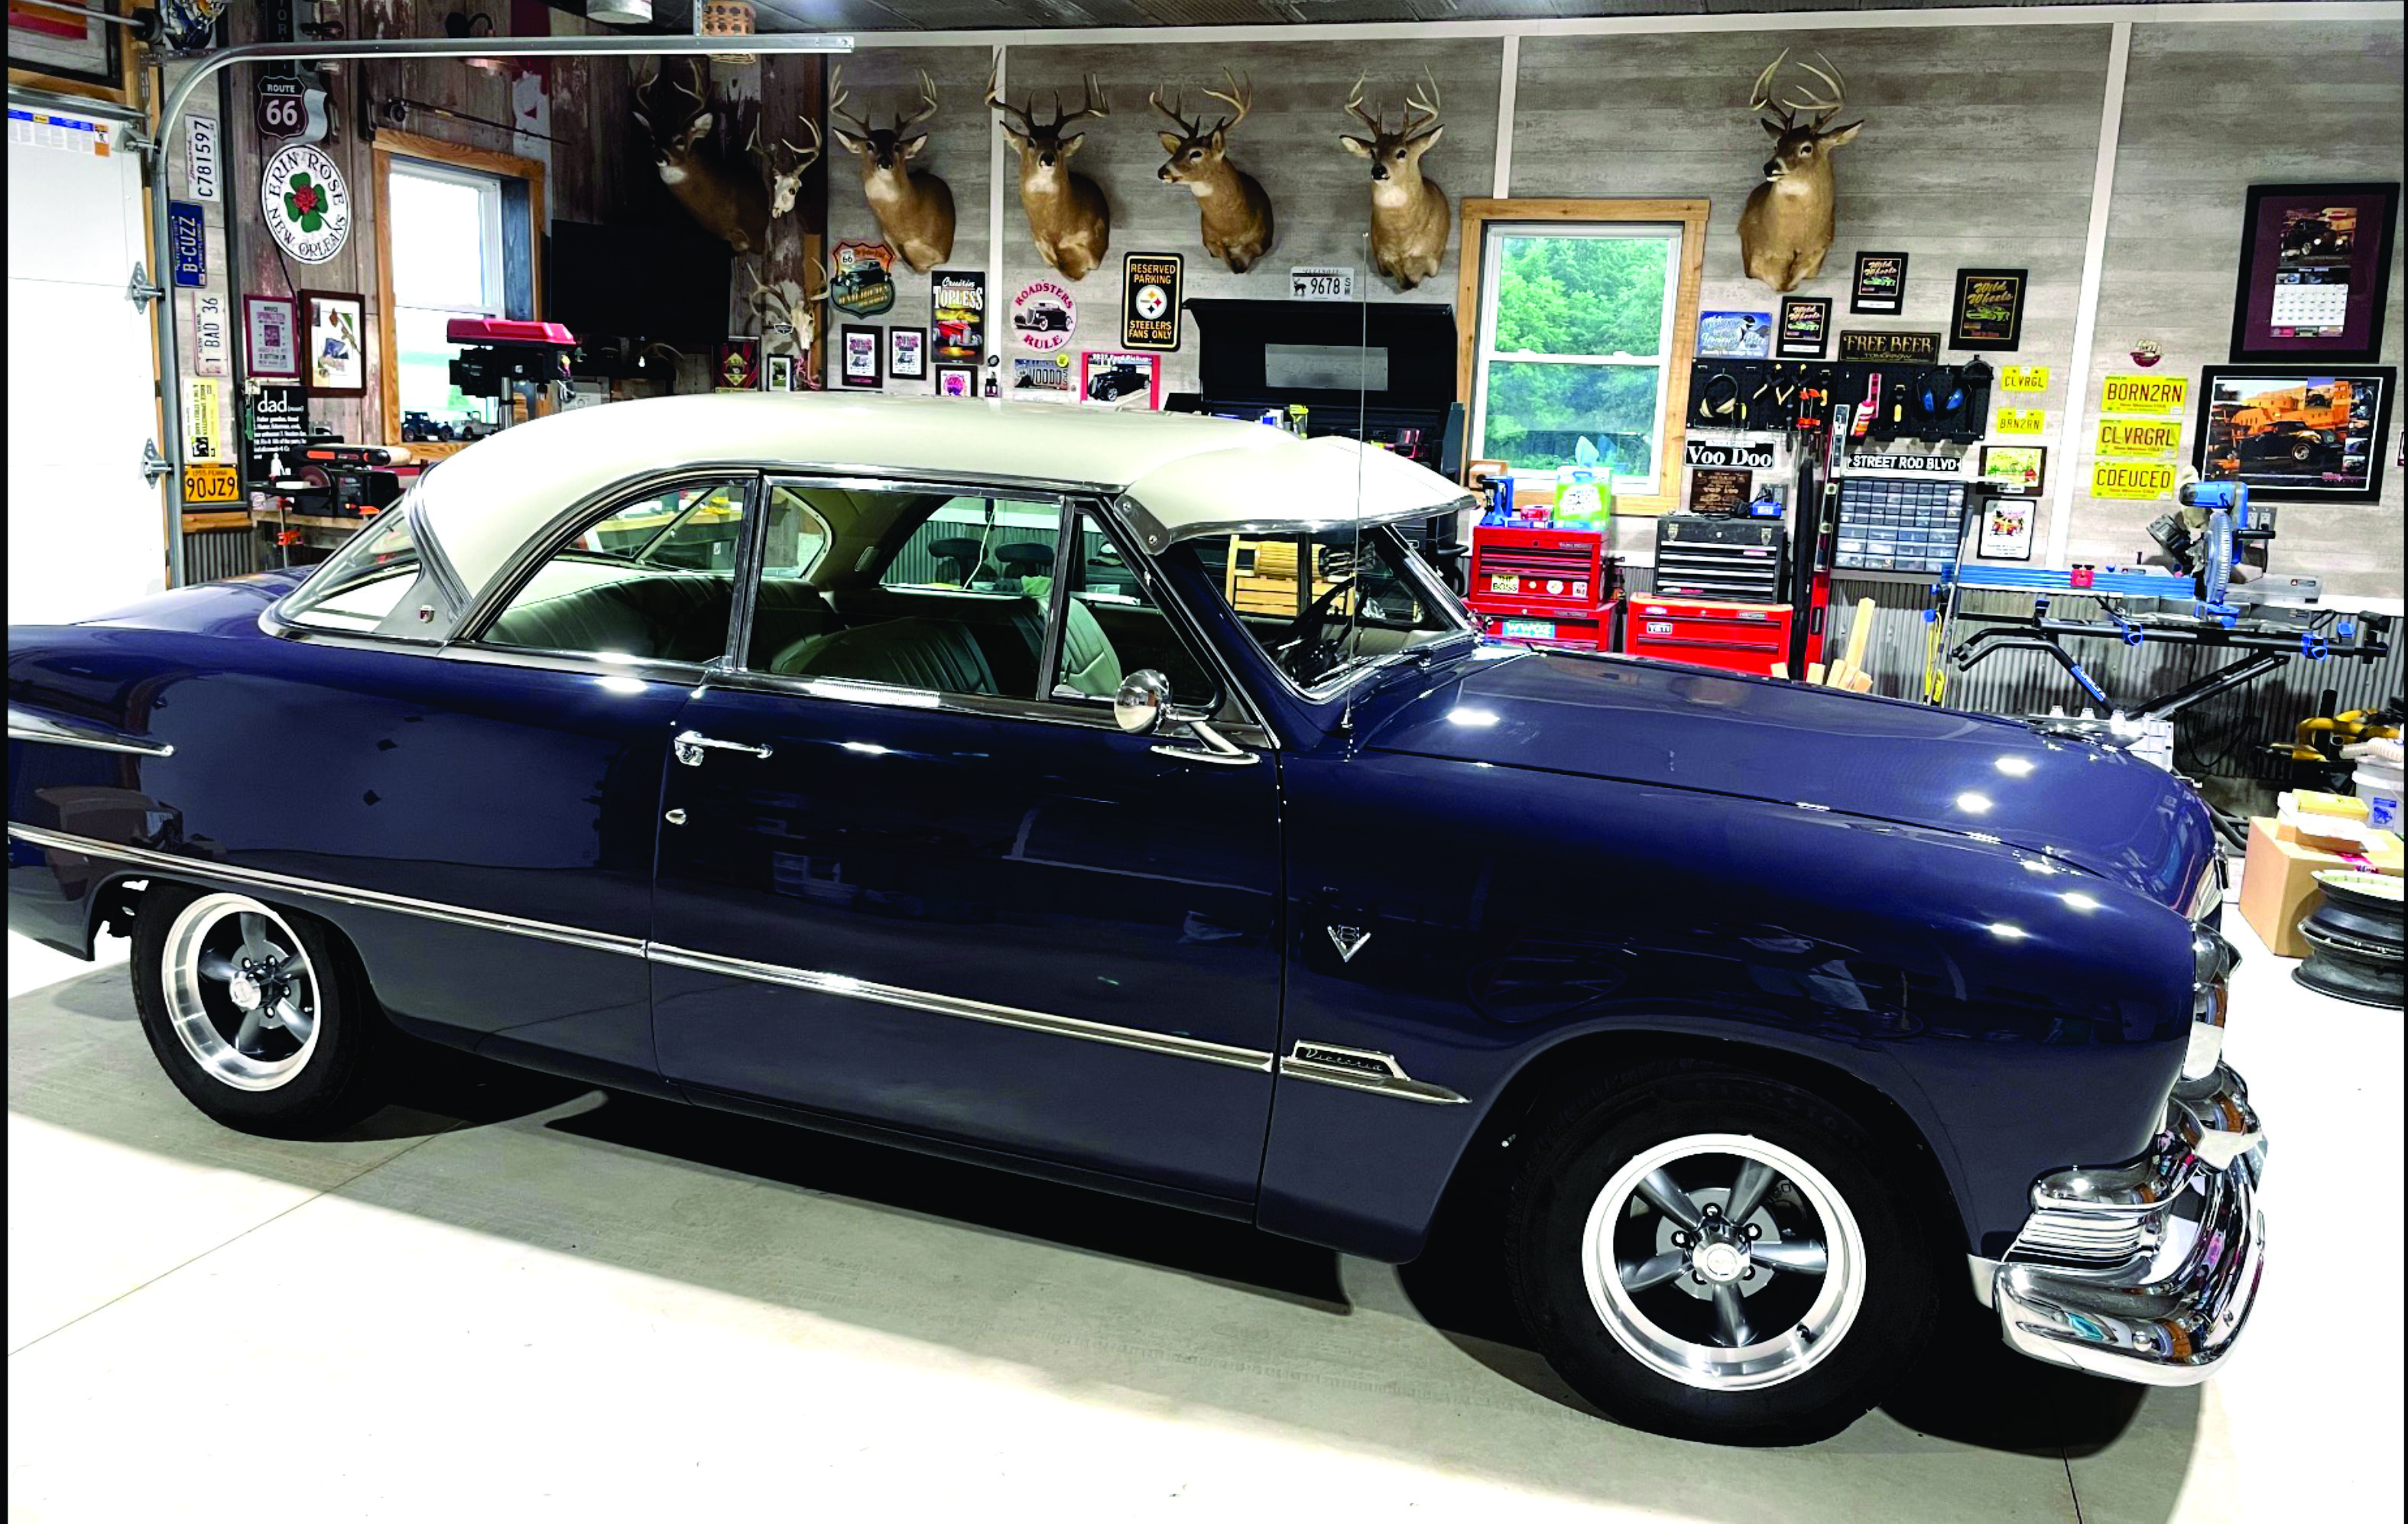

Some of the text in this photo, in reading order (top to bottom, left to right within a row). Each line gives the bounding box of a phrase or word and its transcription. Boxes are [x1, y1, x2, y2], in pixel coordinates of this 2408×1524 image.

[266, 83, 296, 93] ROUTE
[265, 99, 299, 125] 66
[193, 120, 213, 197] C781597
[268, 151, 345, 206] ERIN ROSE
[268, 207, 347, 258] NEW ORLEANS
[178, 216, 198, 272] B-CUZZ
[1131, 264, 1176, 274] RESERVED
[1864, 268, 1897, 276] Wheels
[1134, 274, 1171, 284] PARKING
[1310, 277, 1340, 294] 9678
[1973, 280, 2007, 293] Wild
[933, 285, 983, 310] TOPLESS
[1015, 282, 1073, 309] ROADSTERS
[1967, 292, 2014, 304] Wheels
[201, 297, 219, 314] 36
[1129, 319, 1172, 330] STEELERS
[1789, 312, 1822, 321] Wheels
[203, 323, 220, 348] BAD
[1023, 333, 1063, 349] RULE
[1128, 329, 1172, 339] FANS ONLY
[1845, 335, 1931, 352] FREE BEER
[2107, 382, 2182, 403] BORN2RN
[257, 390, 287, 413] dad
[2000, 418, 2040, 430] BRN2RN
[2101, 426, 2175, 447] CLVRGRL
[1686, 446, 1772, 467] Voo Doo
[1853, 456, 1956, 470] STREET ROD BLVD
[186, 477, 235, 498] 90JZ9
